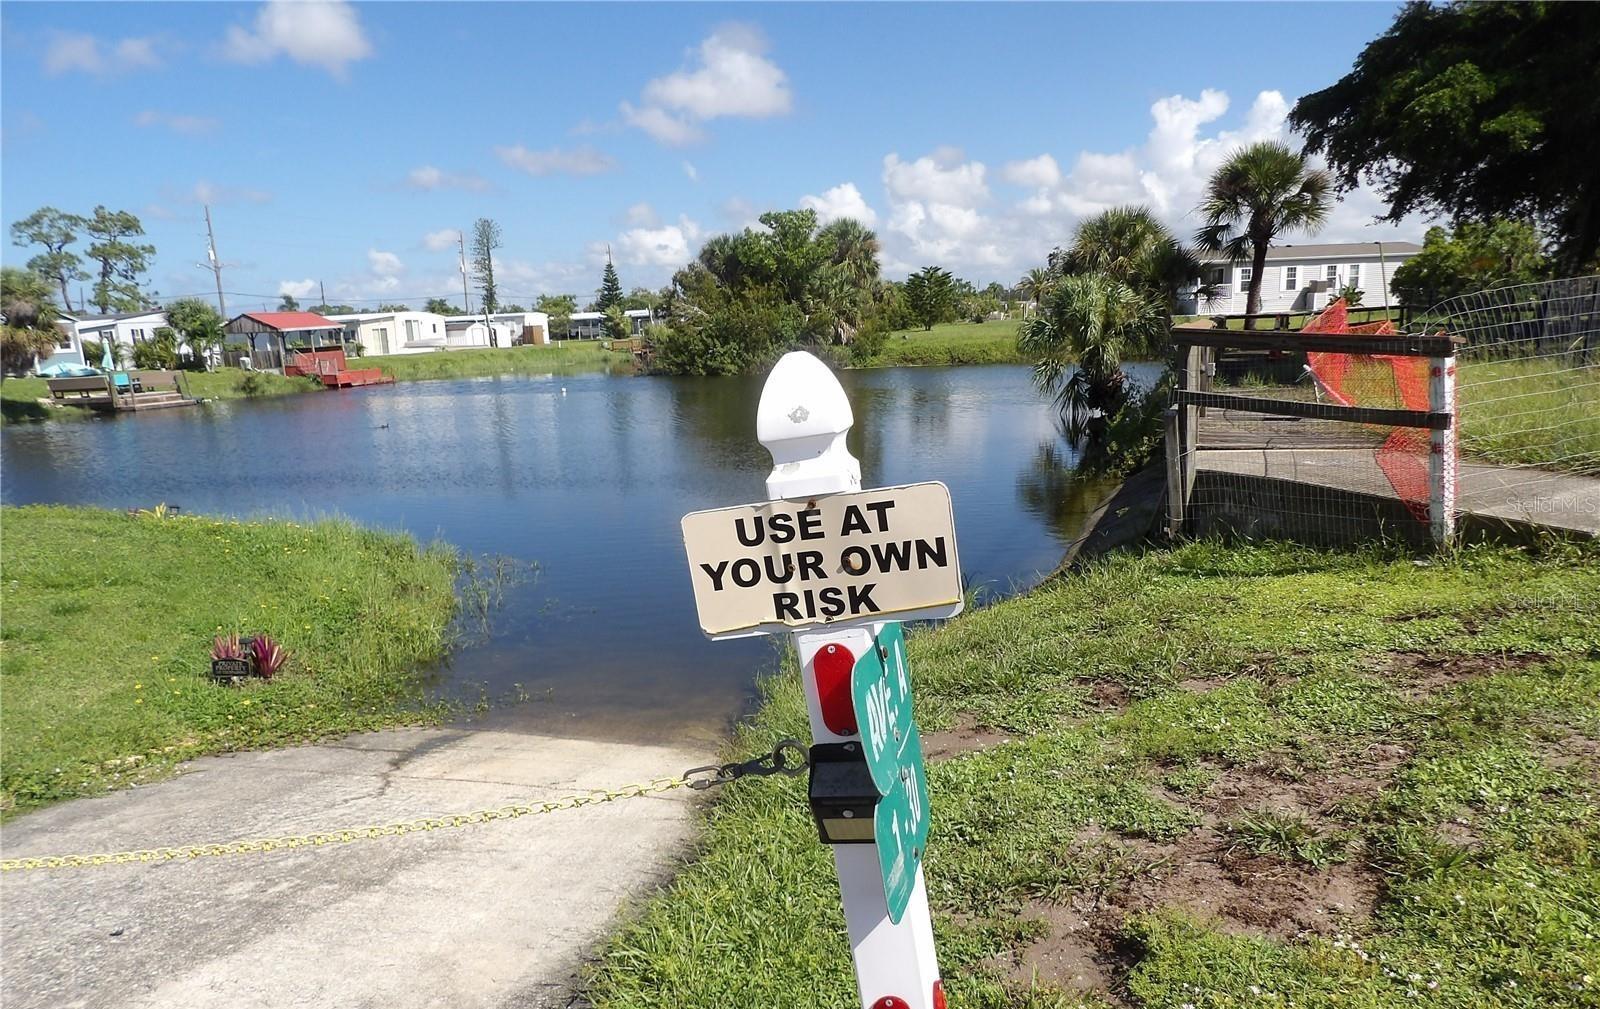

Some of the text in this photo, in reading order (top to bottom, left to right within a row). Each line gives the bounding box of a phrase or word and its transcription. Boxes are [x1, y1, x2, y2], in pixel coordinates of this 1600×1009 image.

[735, 500, 896, 547] USE AT
[700, 537, 948, 591] YOUR OWN
[773, 583, 881, 621] RISK
[894, 638, 908, 703] A
